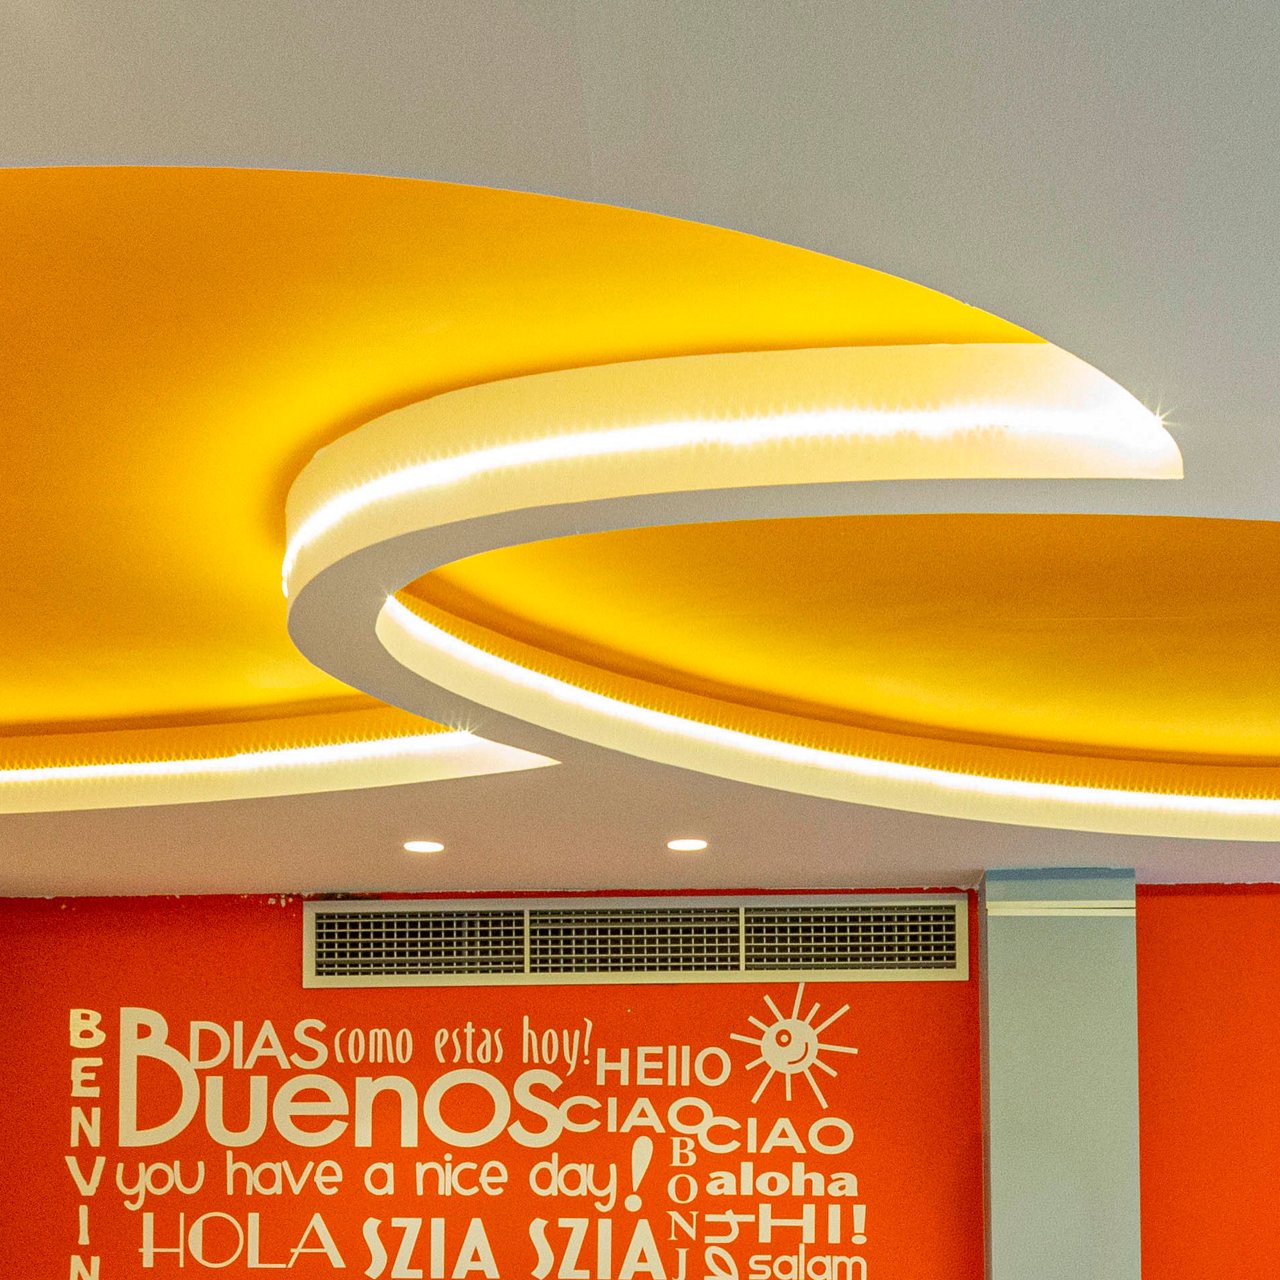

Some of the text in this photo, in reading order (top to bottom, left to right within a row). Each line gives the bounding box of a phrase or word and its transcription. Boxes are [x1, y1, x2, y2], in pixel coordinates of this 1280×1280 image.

[335, 1016, 593, 1076] como estas hoy!
[119, 1007, 562, 1148] Buenos DIAS
[558, 1096, 713, 1133] CIAO
[699, 1116, 854, 1154] CIAO
[116, 1160, 205, 1211] you
[226, 1150, 343, 1196] have
[364, 1162, 395, 1196] a
[416, 1153, 509, 1197] nice
[705, 1161, 858, 1197] aloha
[138, 1211, 346, 1269] HOLA
[363, 1217, 667, 1280] SZIA SZIA
[759, 1203, 868, 1245] HI!
[748, 1243, 868, 1280] salam
